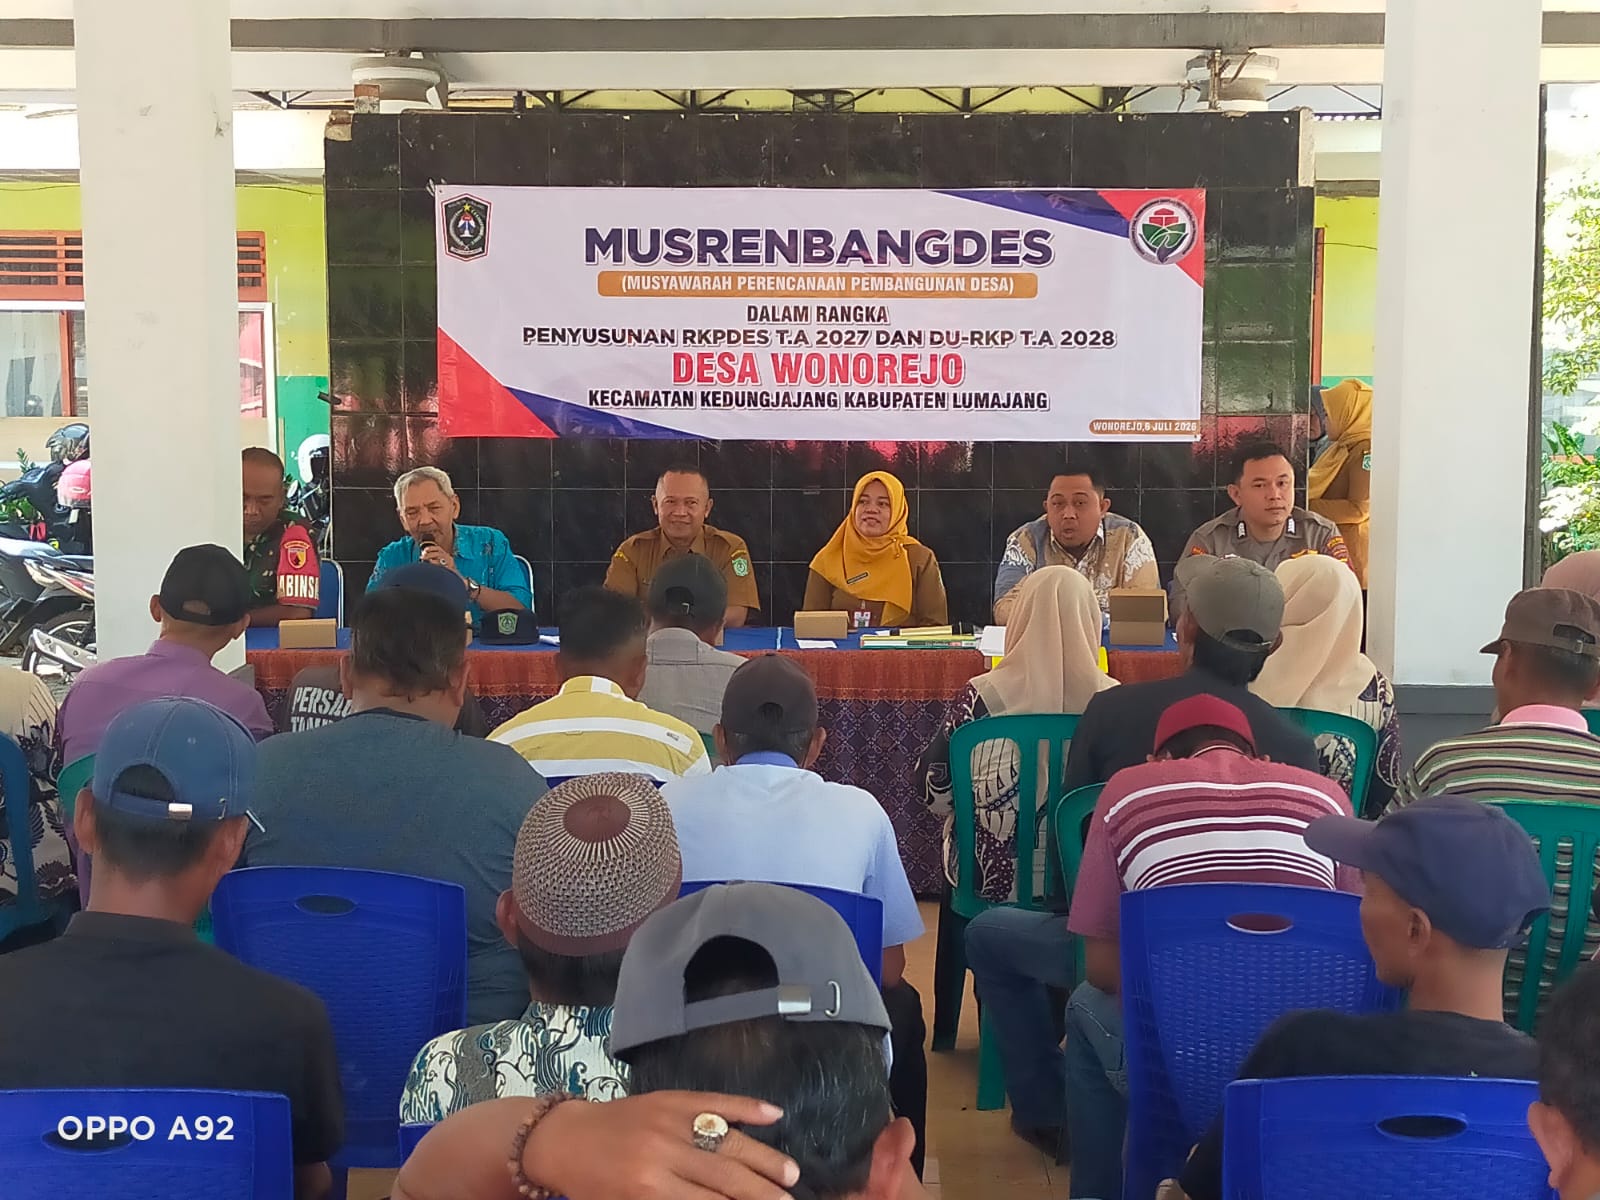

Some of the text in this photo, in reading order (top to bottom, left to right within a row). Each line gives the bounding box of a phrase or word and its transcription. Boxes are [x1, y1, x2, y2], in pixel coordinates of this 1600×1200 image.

[585, 227, 1053, 265] MUSRENBANGDES
[621, 274, 1014, 295] (MUSYAWARAH PERENCANAAN PEMBANGUNAN DESA)
[747, 305, 889, 323] DALAM RANGKA
[523, 327, 1115, 346] PENYUSUNAN RKPDES T.A 2027 DAN DU-RKP T.A 2028
[673, 352, 964, 385] DESA WONOREJO
[588, 389, 1048, 409] KECAMATAN KEDUNGJAJANG KABUPATEN LUMAJANG
[1152, 421, 1172, 431] JULI
[277, 574, 319, 600] ABINS
